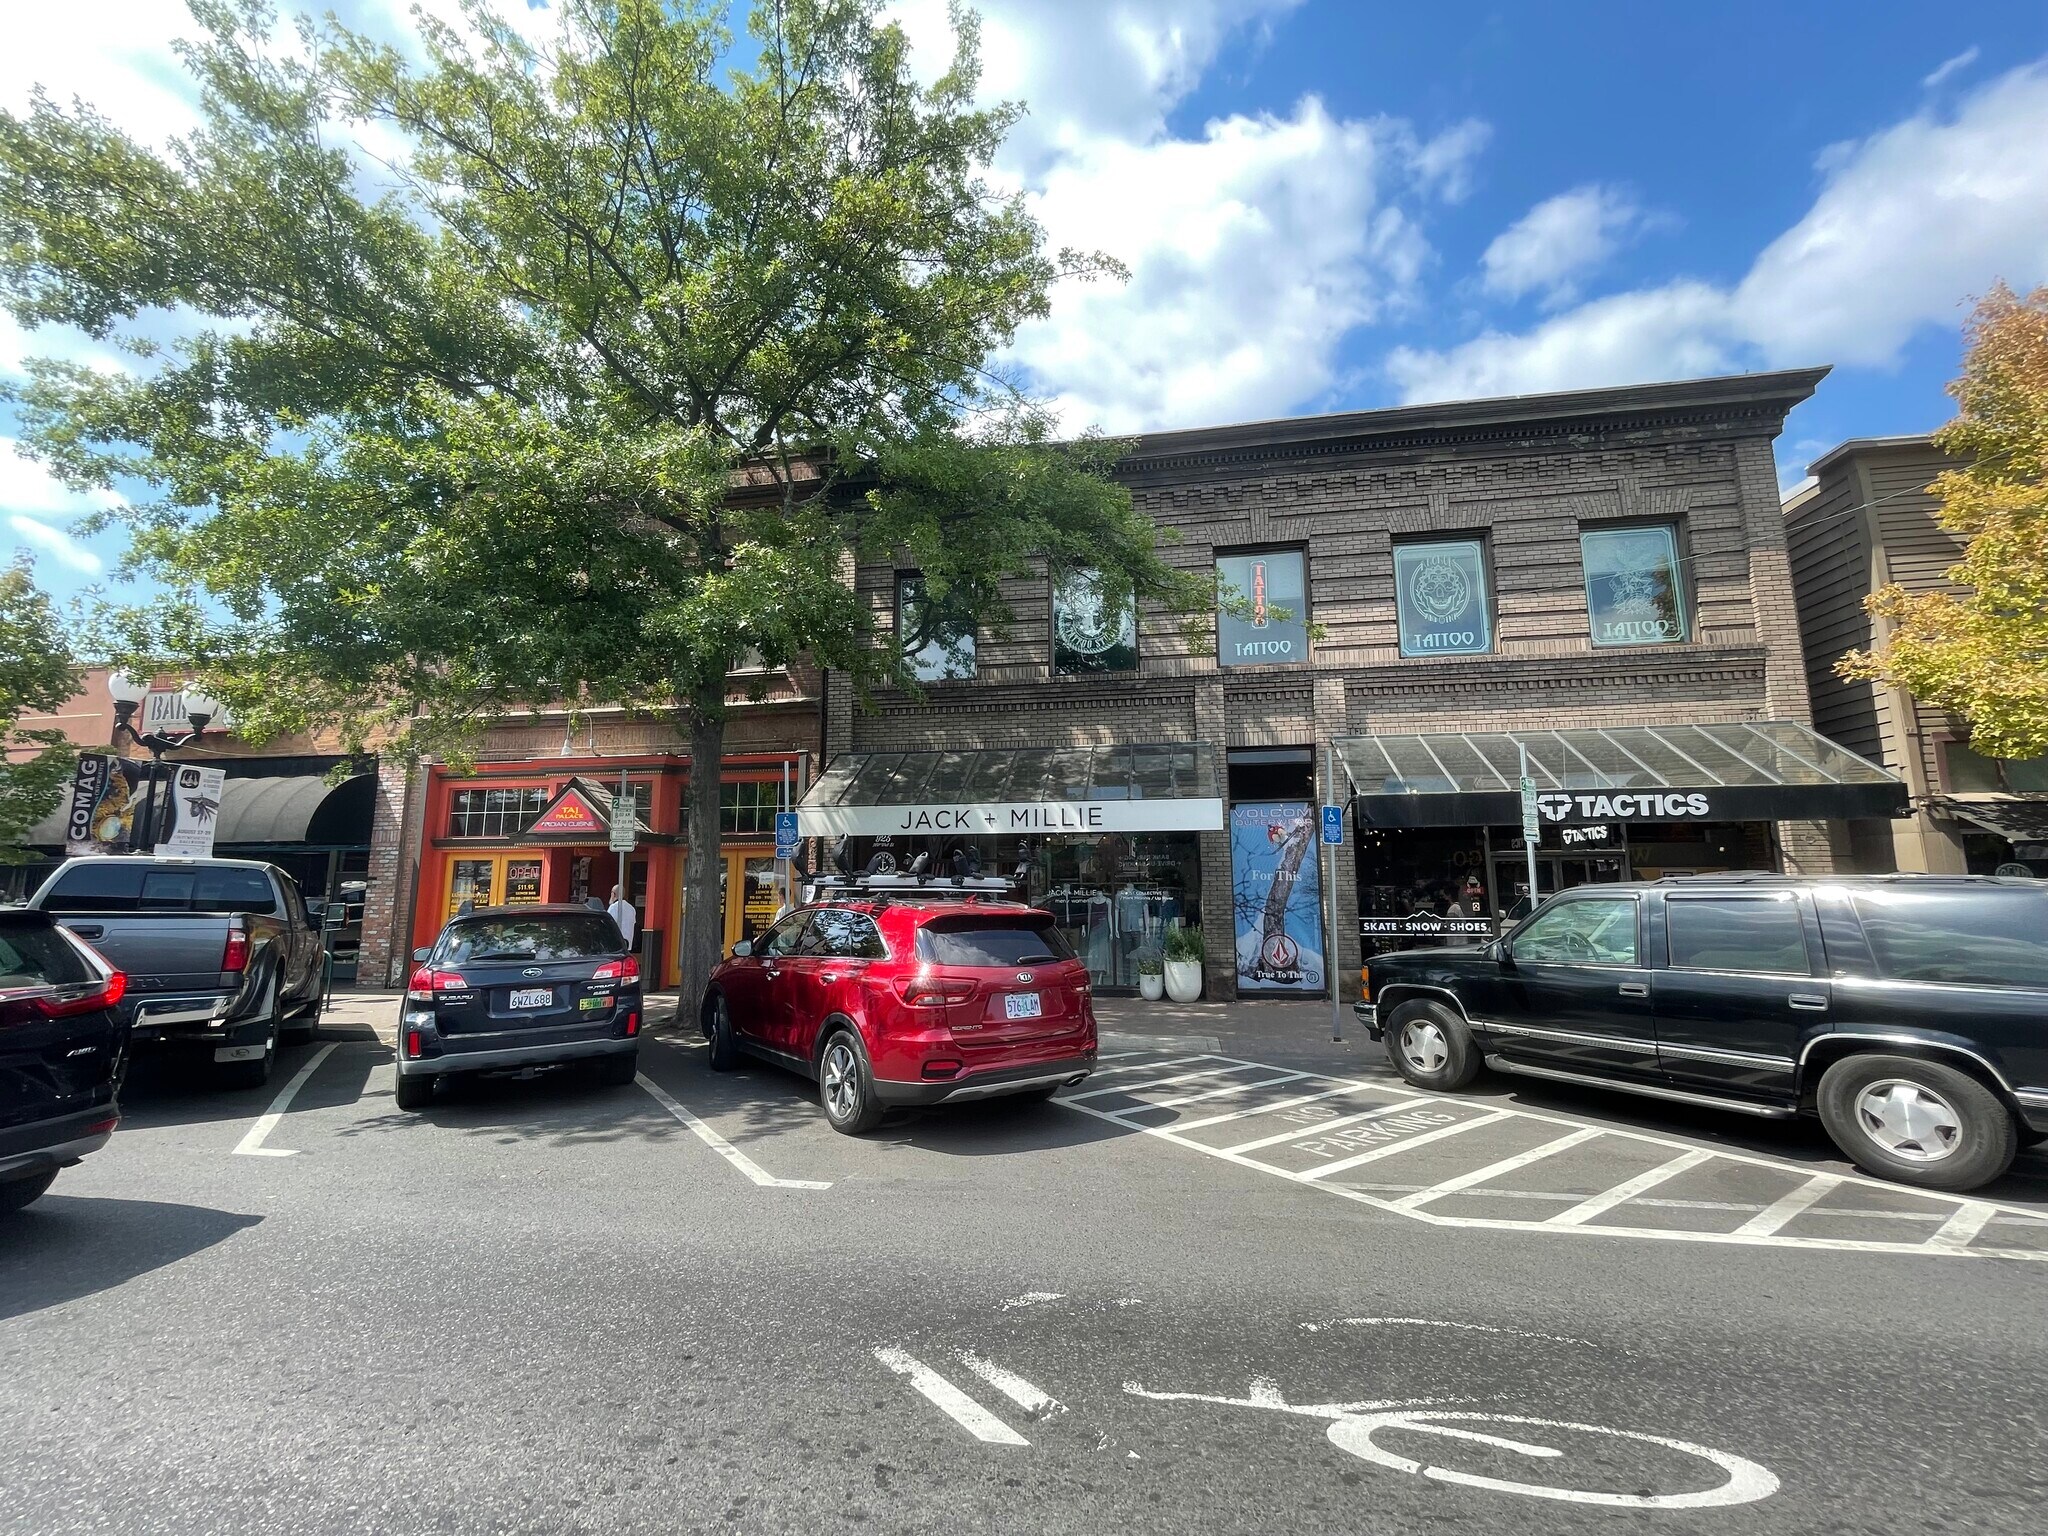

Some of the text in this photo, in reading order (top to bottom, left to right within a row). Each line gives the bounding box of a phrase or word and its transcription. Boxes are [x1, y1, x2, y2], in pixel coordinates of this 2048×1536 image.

[1254, 564, 1265, 626] TATTOO
[1603, 620, 1669, 637] TATTOO
[1414, 631, 1475, 648] TATTOO
[1235, 640, 1292, 657] TATTOO
[70, 759, 97, 840] COMAG
[613, 799, 619, 808] 2
[1575, 793, 1710, 818] TACTICS
[900, 809, 971, 829] JACK
[1011, 807, 1103, 828] MILLIE
[1233, 808, 1313, 819] VOLCOM
[1571, 826, 1608, 842] TACTICS
[509, 866, 541, 879] OPEN
[1252, 870, 1302, 882] For This
[1046, 889, 1066, 897] JACK
[1363, 922, 1487, 931] SKATE SNOW SHOES
[1256, 970, 1274, 979] True
[1276, 971, 1287, 979] To
[511, 994, 550, 1006] 6WZL688
[1007, 999, 1039, 1012] 576 LAM
[1272, 1106, 1340, 1124] NO
[1291, 1110, 1456, 1158] PARKING
